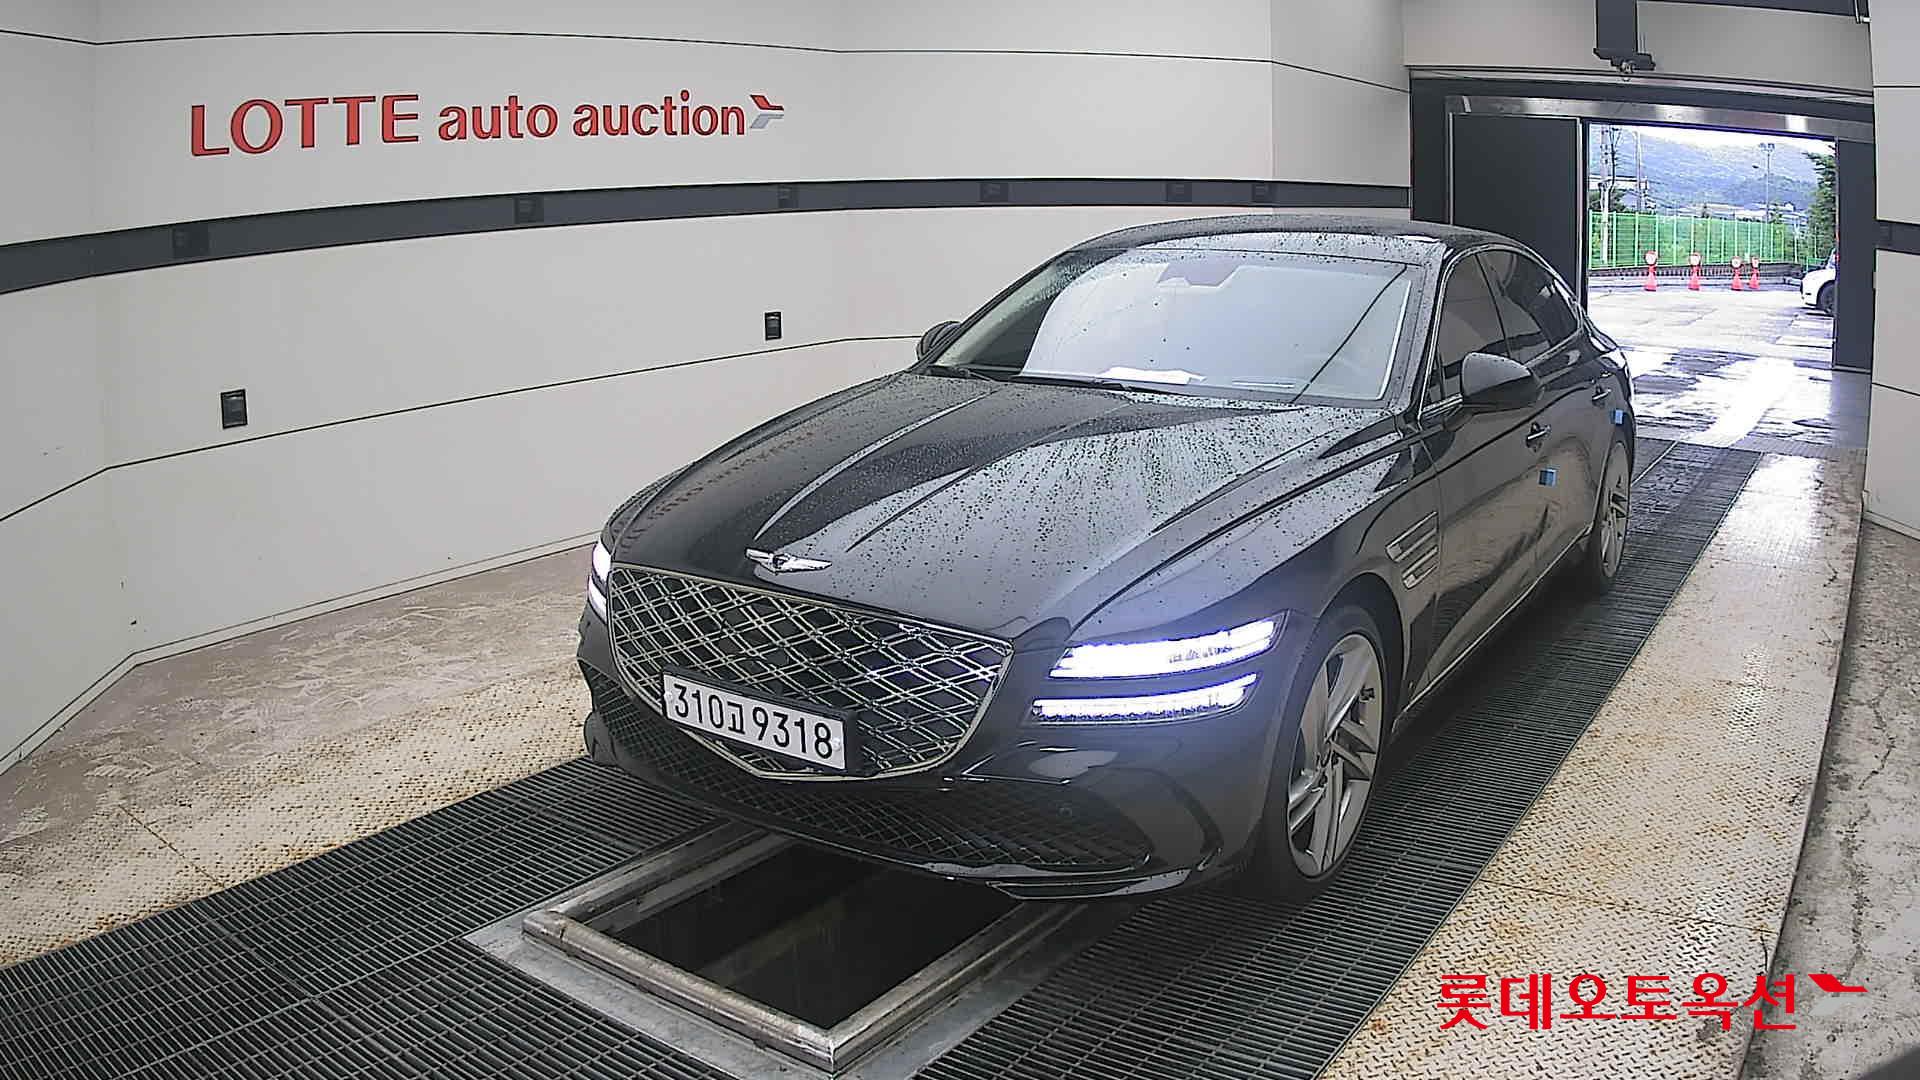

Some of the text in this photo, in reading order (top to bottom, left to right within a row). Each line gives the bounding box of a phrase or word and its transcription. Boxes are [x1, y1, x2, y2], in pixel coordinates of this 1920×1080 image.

[191, 89, 746, 157] LOTTE auto auction
